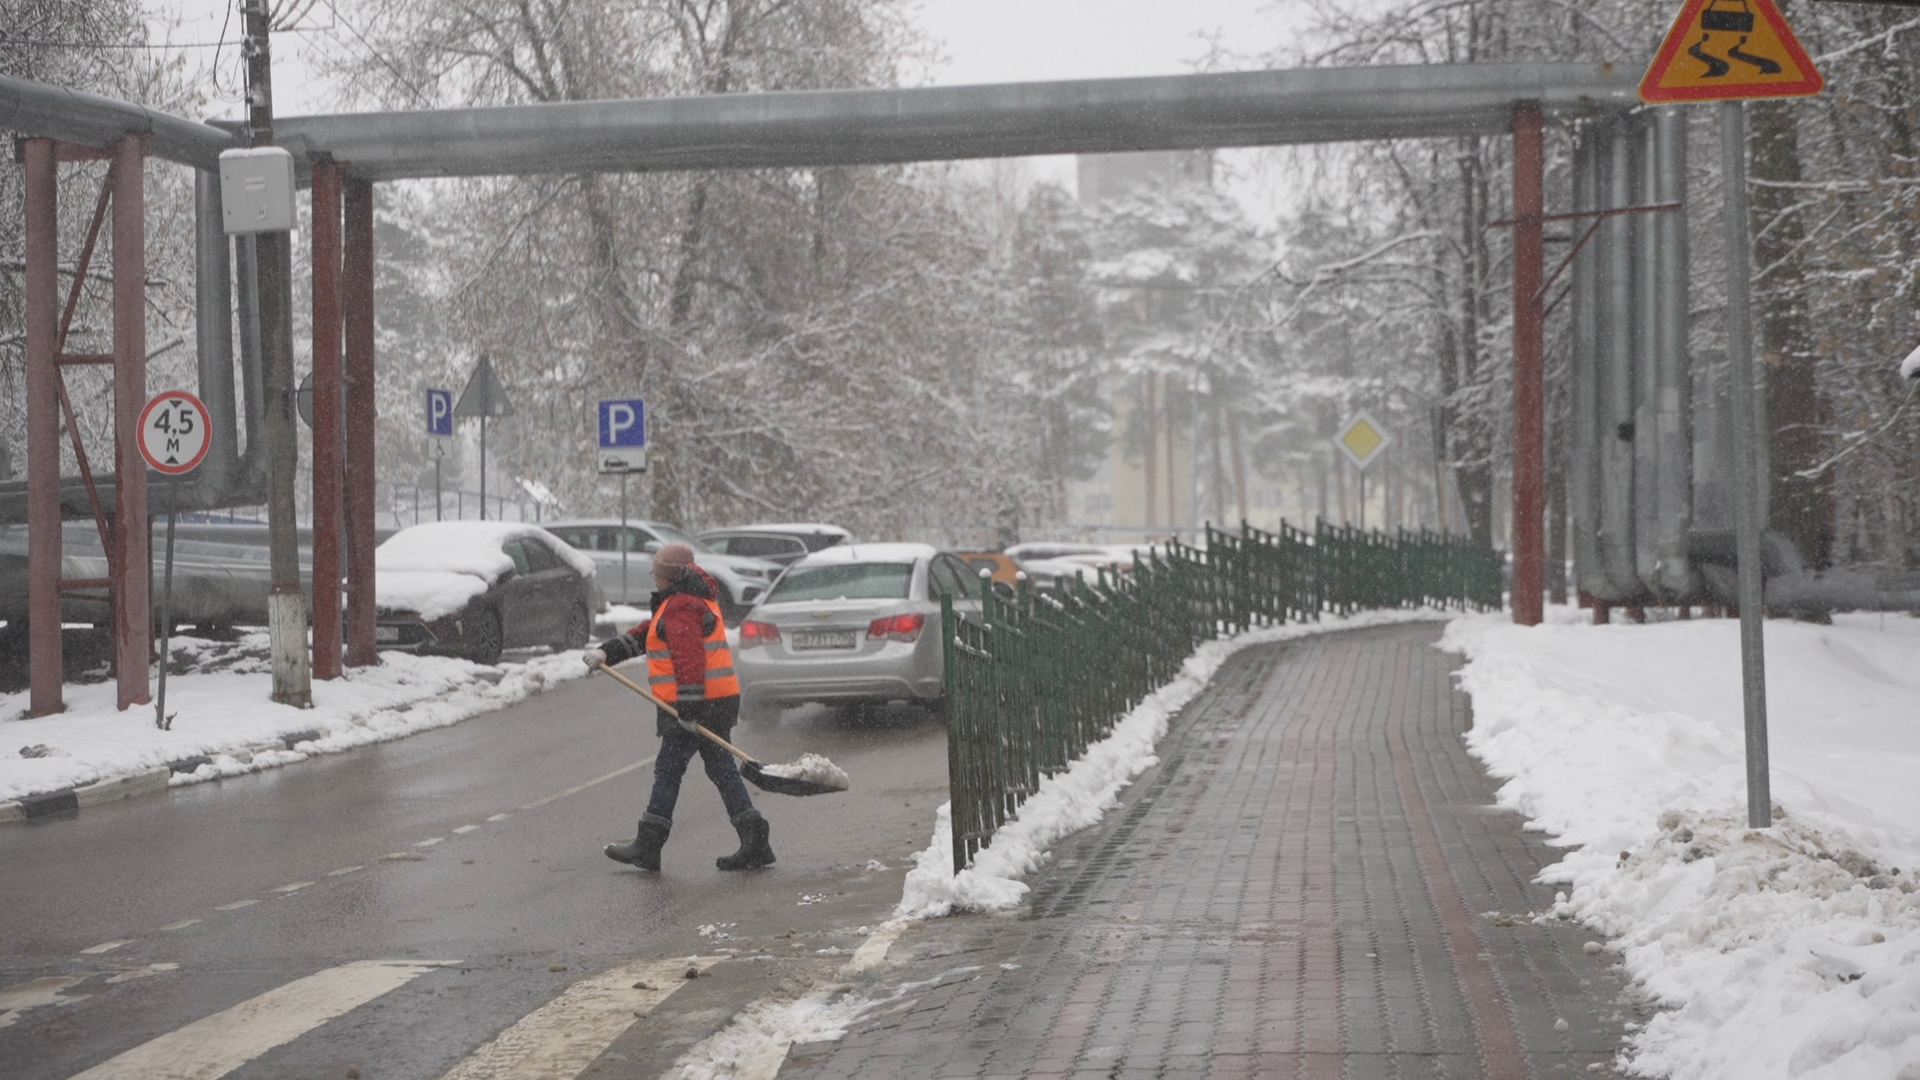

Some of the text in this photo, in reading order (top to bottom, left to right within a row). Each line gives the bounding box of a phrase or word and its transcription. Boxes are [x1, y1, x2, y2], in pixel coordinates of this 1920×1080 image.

[153, 408, 194, 438] 4,5
[432, 392, 447, 432] P
[609, 404, 635, 445] P
